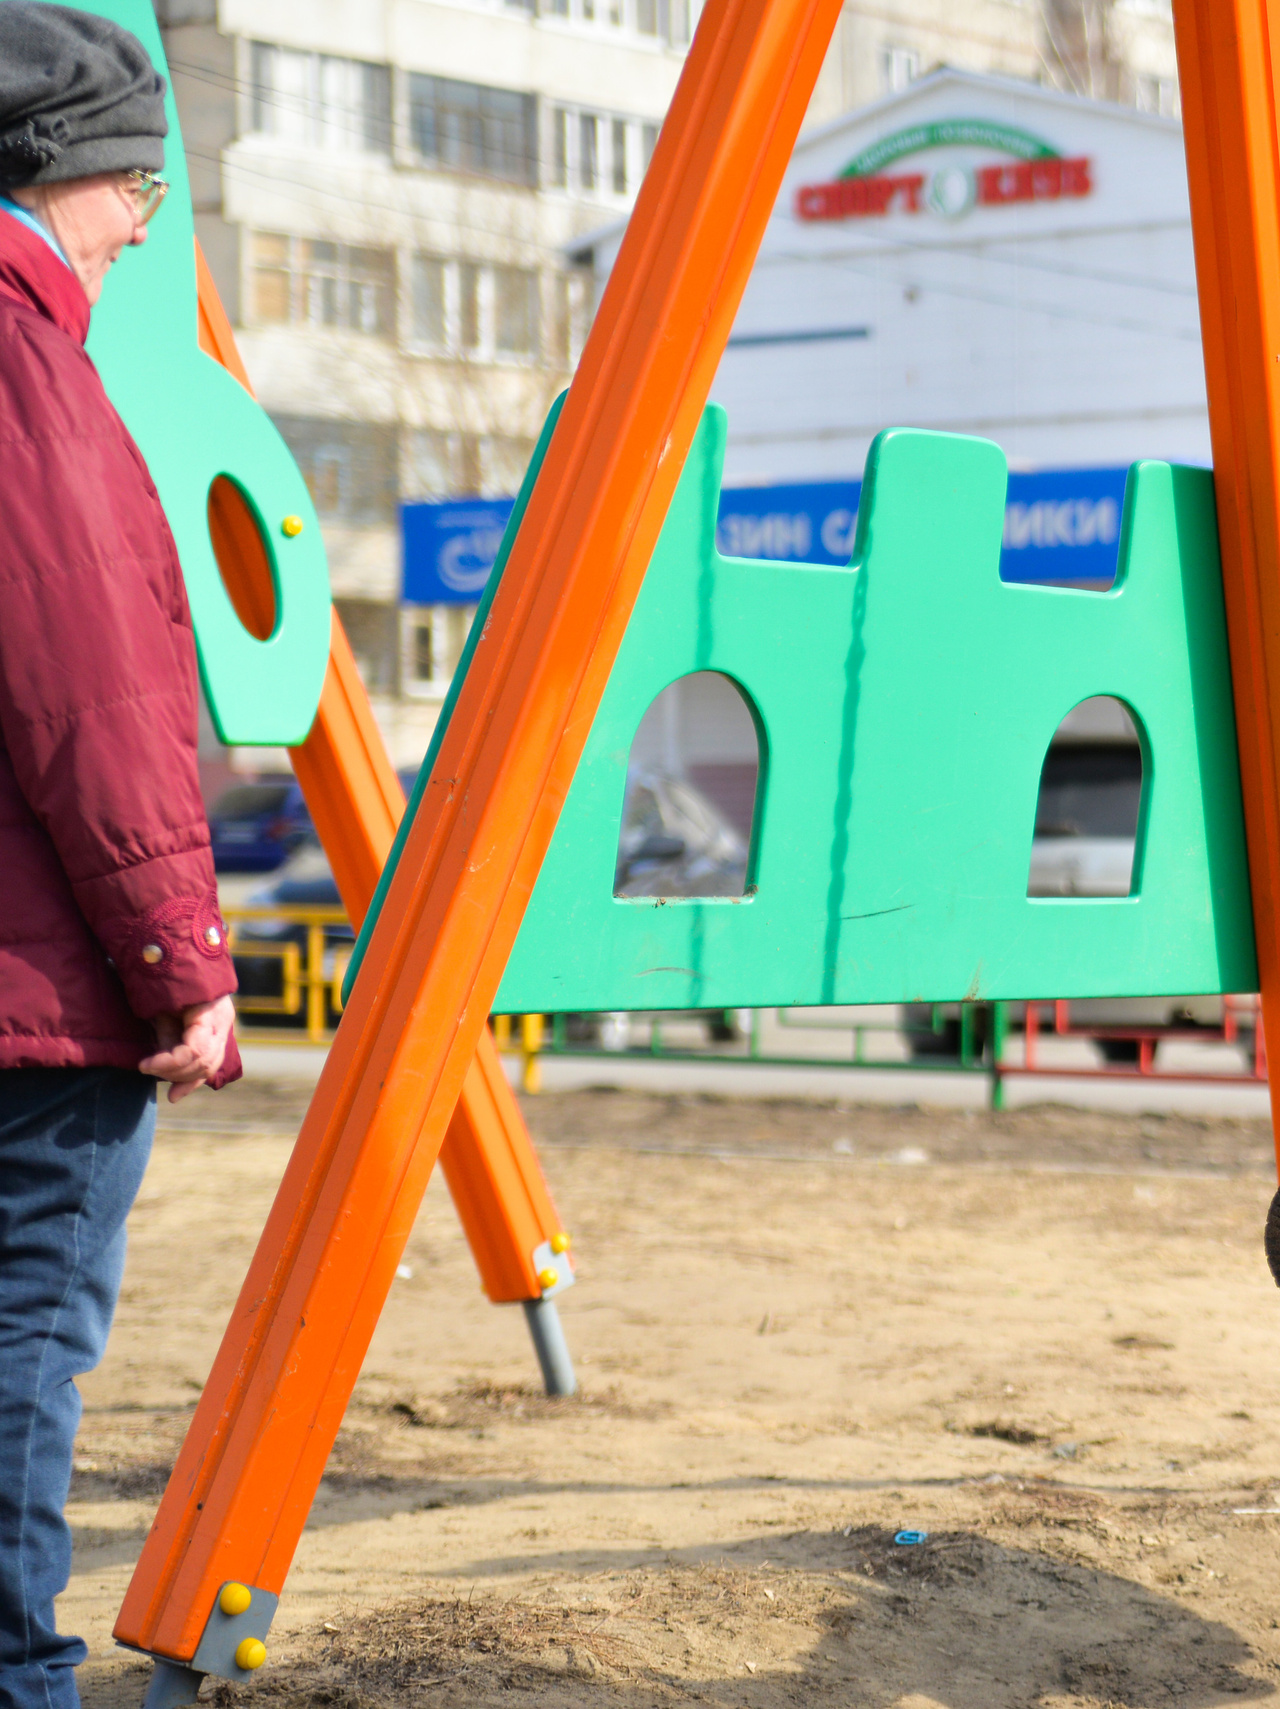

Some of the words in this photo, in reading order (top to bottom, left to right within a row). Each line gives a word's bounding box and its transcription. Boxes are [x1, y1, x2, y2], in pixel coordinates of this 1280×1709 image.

[795, 172, 926, 221] СПОРТ
[717, 512, 812, 558] ЗИН
[1002, 496, 1118, 550] ИКИ
